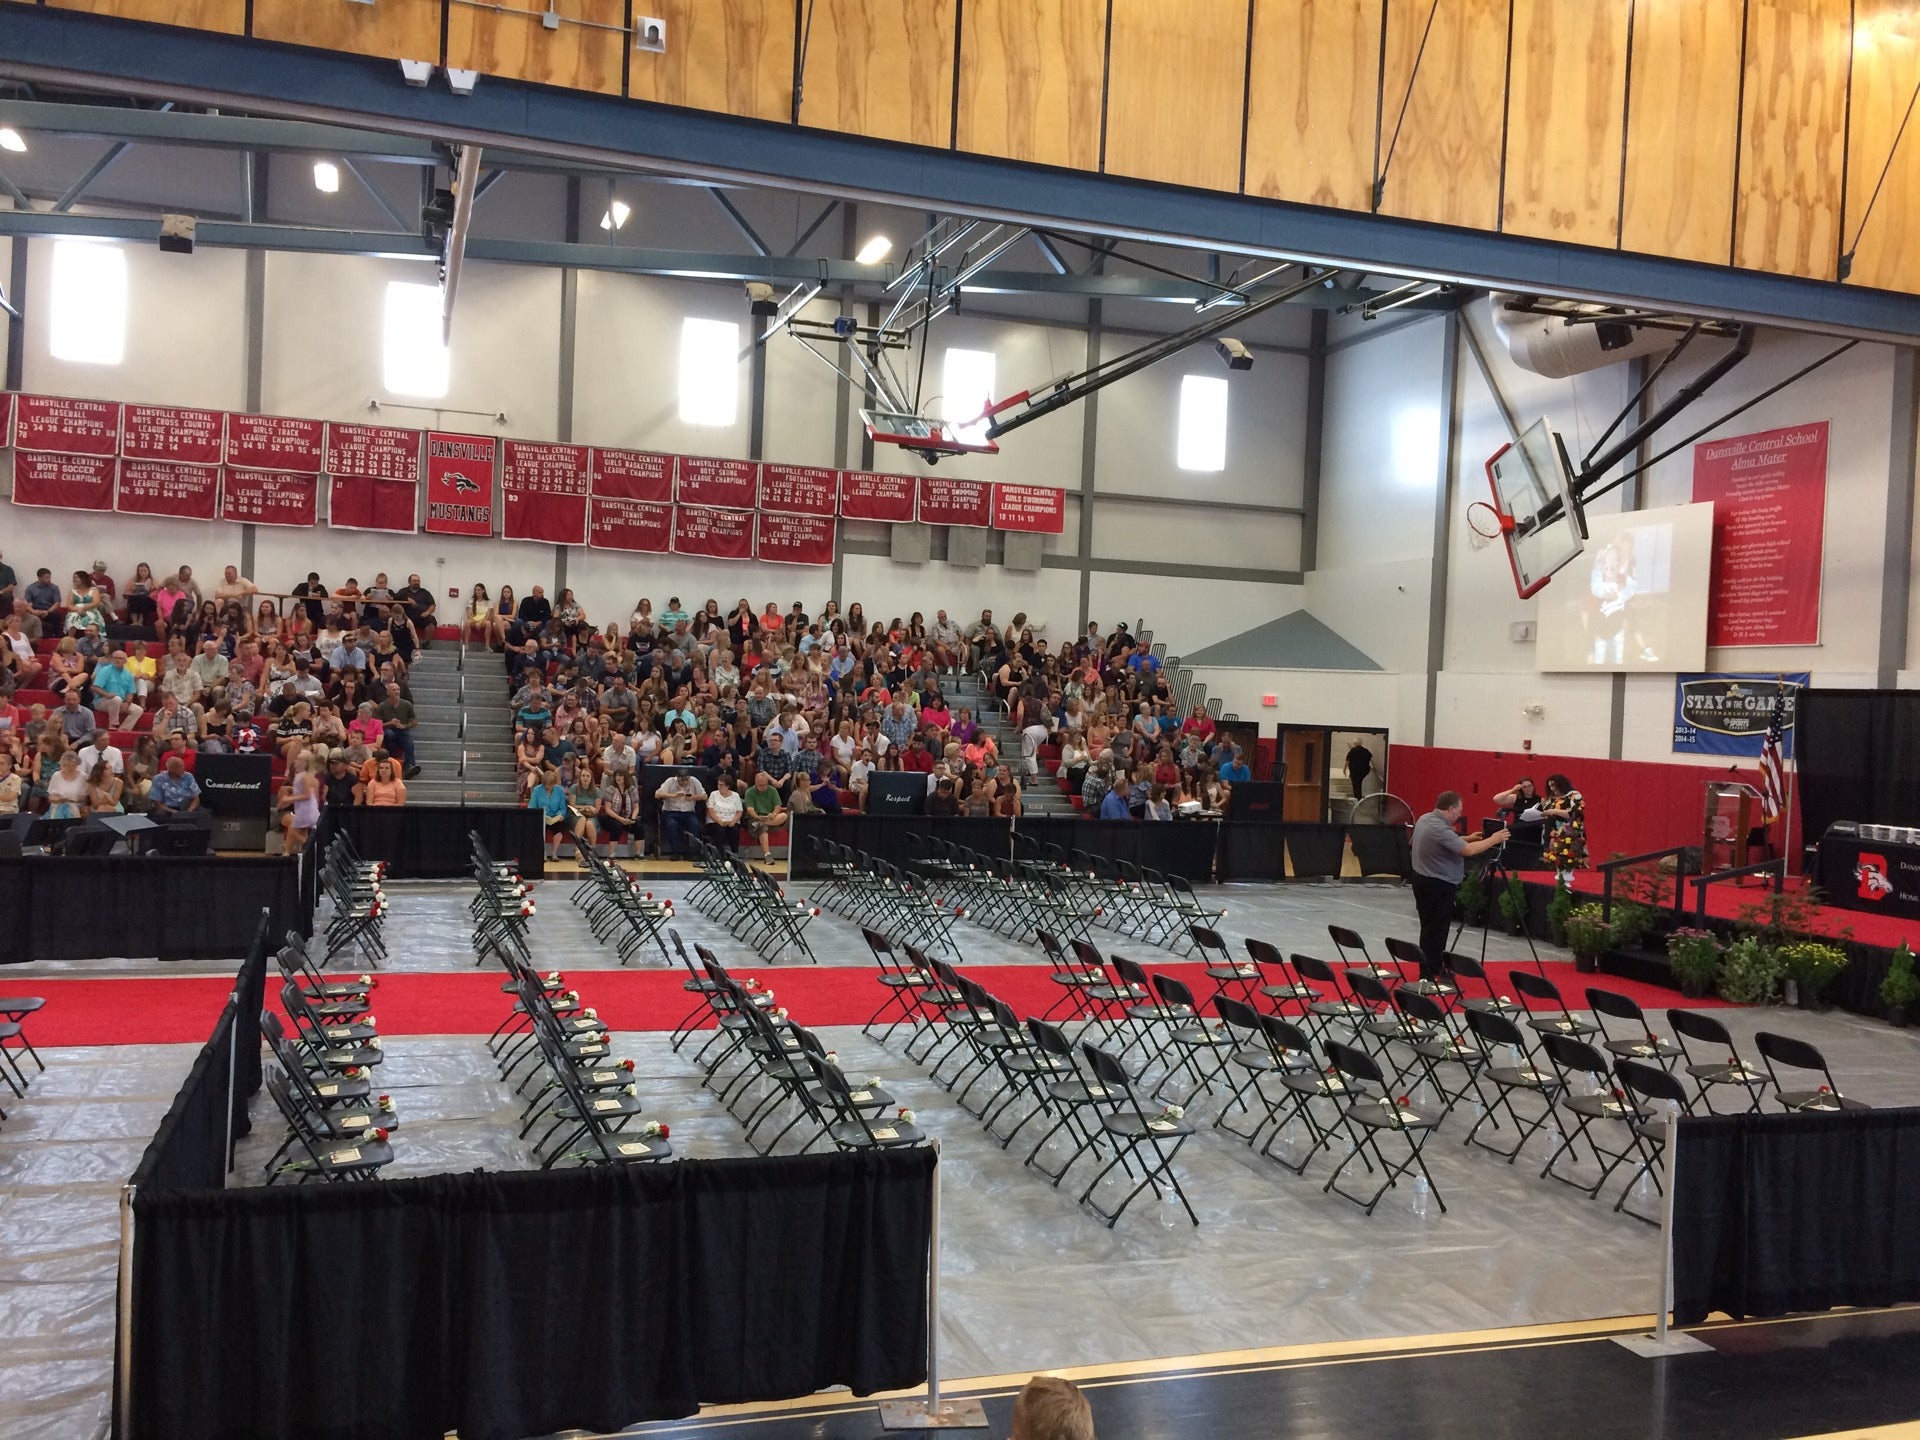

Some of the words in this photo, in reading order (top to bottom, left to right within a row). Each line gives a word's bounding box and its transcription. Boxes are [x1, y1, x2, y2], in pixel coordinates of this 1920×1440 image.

[30, 399, 70, 408] DANSVILLE
[75, 402, 106, 412] CENTRAL
[50, 408, 86, 418] BASEBALL
[137, 408, 175, 418] DANSVILLE
[180, 412, 212, 421] CENTRAL
[31, 416, 59, 424] LEAGUE
[64, 418, 104, 428] CHAMPIONS
[133, 416, 151, 424] BOYS
[156, 418, 179, 426] CROSS
[184, 420, 215, 429] COUNTRY
[240, 417, 277, 427] DANSVILLE
[282, 421, 312, 430] CENTRAL
[139, 426, 166, 434] LEAGUE
[171, 428, 209, 438] CHAMPIONS
[253, 426, 273, 435] GIRLS
[278, 428, 299, 436] TRACK
[340, 426, 376, 436] DANSVILLE
[380, 430, 408, 439] CENTRAL
[242, 434, 268, 442] LEAGUE
[273, 436, 310, 446] CHAMPIONS
[1706, 442, 1747, 459] Dansville
[1749, 435, 1784, 450] Central
[1785, 430, 1819, 445] School
[371, 445, 406, 455] CHAMPIONS
[431, 440, 493, 462] DANSVILLE
[514, 444, 548, 453] DANSVILLE
[552, 447, 578, 455] CENTRAL
[27, 455, 67, 463] DANSVILLE
[72, 458, 104, 467] CENTRAL
[537, 453, 576, 462] BASKETBALL
[603, 451, 635, 461] DANSVILLE
[639, 455, 665, 464] CENTRAL
[1731, 458, 1755, 470] Alma
[1758, 453, 1787, 465] Mater
[62, 465, 95, 474] SOCCER
[132, 463, 170, 472] DANSVILLE
[175, 466, 206, 475] CENTRAL
[516, 460, 540, 468] LEAGUE
[544, 462, 576, 470] CHAMPIONS
[626, 462, 662, 471] BASKETBALL
[689, 459, 720, 468] DANSVILLE
[724, 462, 748, 470] CENTRAL
[30, 471, 56, 480] LEAGUE
[62, 473, 102, 483] CHAMPIONS
[236, 472, 273, 482] DANSVILLE
[630, 470, 663, 478] CHAMPIONS
[771, 466, 801, 475] DANSVILLE
[805, 469, 829, 478] CENTRAL
[152, 472, 174, 481] CROSS
[180, 475, 211, 485] COUNTRY
[716, 476, 746, 485] CHAMPIONS
[786, 475, 814, 483] FOOTBALL
[851, 474, 880, 482] DANSVILLE
[133, 480, 160, 488] LEAGUE
[165, 482, 204, 492] CHAMPIONS
[796, 483, 826, 492] CHAMPIONS
[929, 480, 956, 488] DANSVILLE
[237, 488, 263, 497] LEAGUE
[268, 490, 304, 500] CHAMPIONS
[1002, 486, 1032, 494] DANSVILLE
[1033, 489, 1057, 497] CENTRAL
[1023, 496, 1054, 505] SWIMMING
[429, 502, 490, 523] MUSTANGS
[602, 501, 634, 511] DANSVILLE
[638, 505, 663, 514] CENTRAL
[1024, 505, 1057, 514] CHAMPIONS
[686, 509, 717, 519] DANSVILLE
[629, 520, 661, 528] CHAMPIONS
[769, 516, 799, 525] DANSVILLE
[802, 518, 826, 527] CENTRAL
[687, 524, 708, 532] LEAGUE
[712, 526, 743, 536] CHAMPIONS
[794, 532, 823, 541] CHAMPIONS
[1686, 695, 1725, 710] STAY
[205, 778, 261, 789] Commitment
[886, 794, 911, 803] Respect
